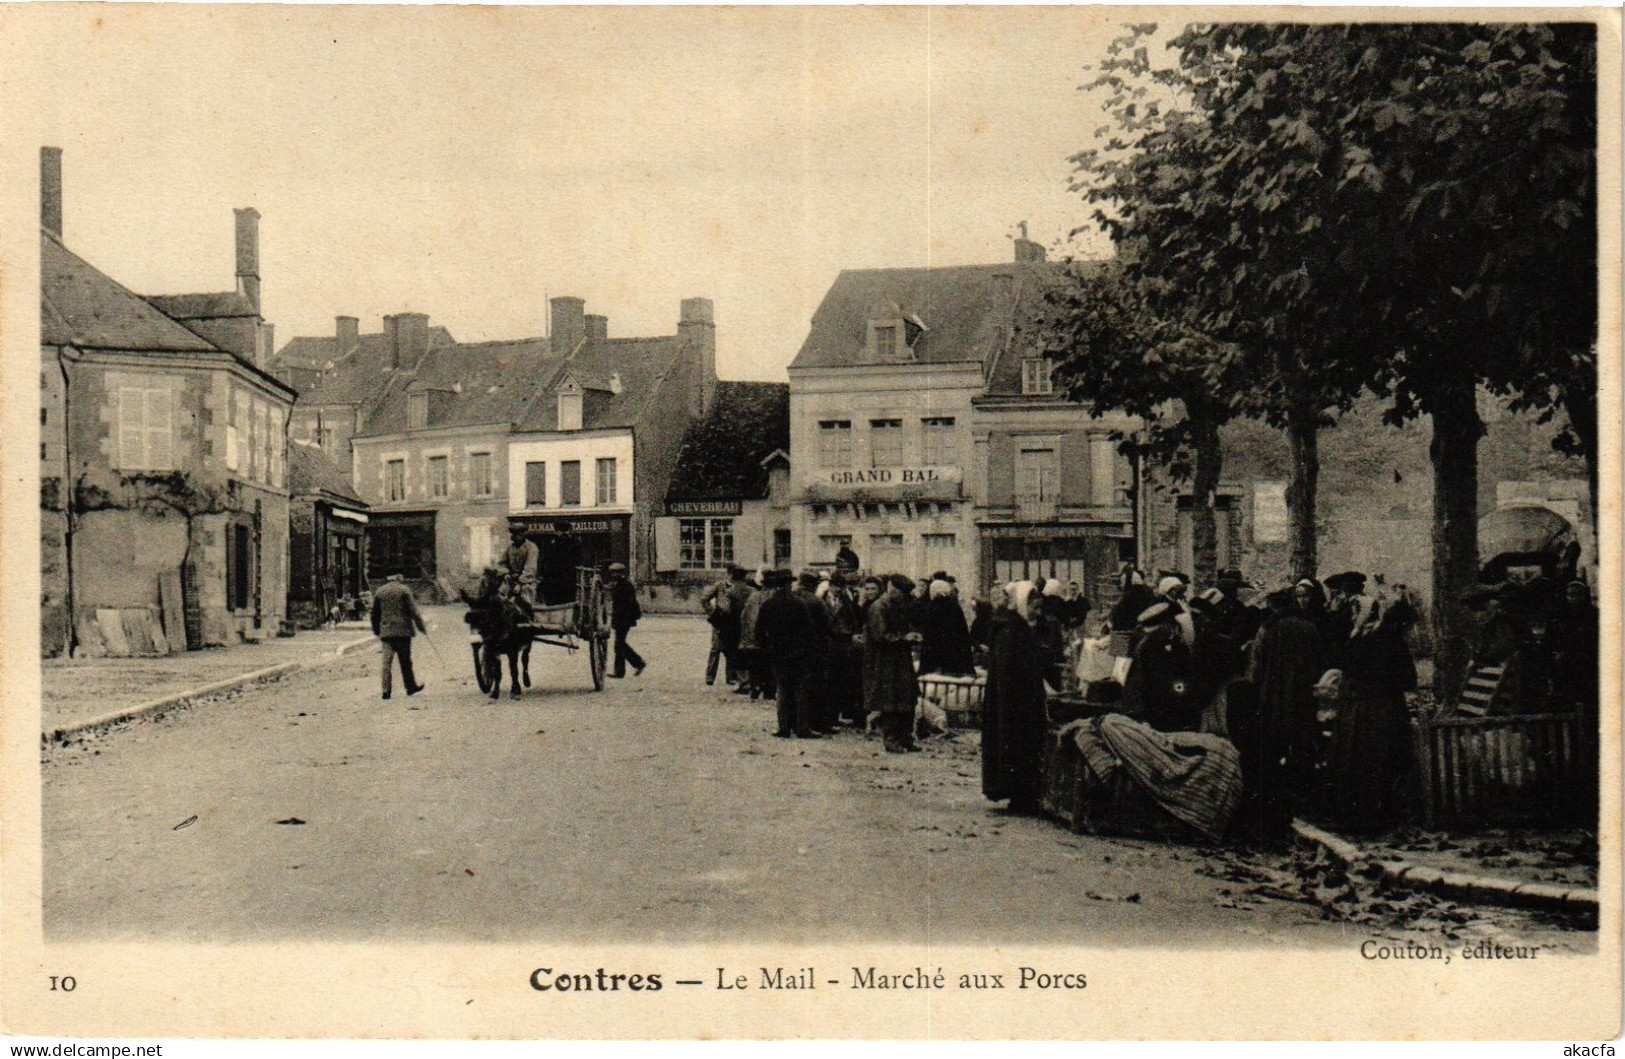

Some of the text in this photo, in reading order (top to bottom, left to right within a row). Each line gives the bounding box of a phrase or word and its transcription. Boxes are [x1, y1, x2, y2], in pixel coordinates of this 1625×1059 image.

[831, 469, 939, 484] GRAND BAL
[570, 521, 608, 531] TAILLEUR
[1360, 938, 1540, 965] Couton, éditeur
[529, 968, 663, 992] Contres
[717, 967, 747, 990] Le
[760, 967, 816, 990] Mail
[851, 967, 945, 989] Marché
[959, 974, 1005, 989] aux
[1019, 967, 1088, 989] Porcs
